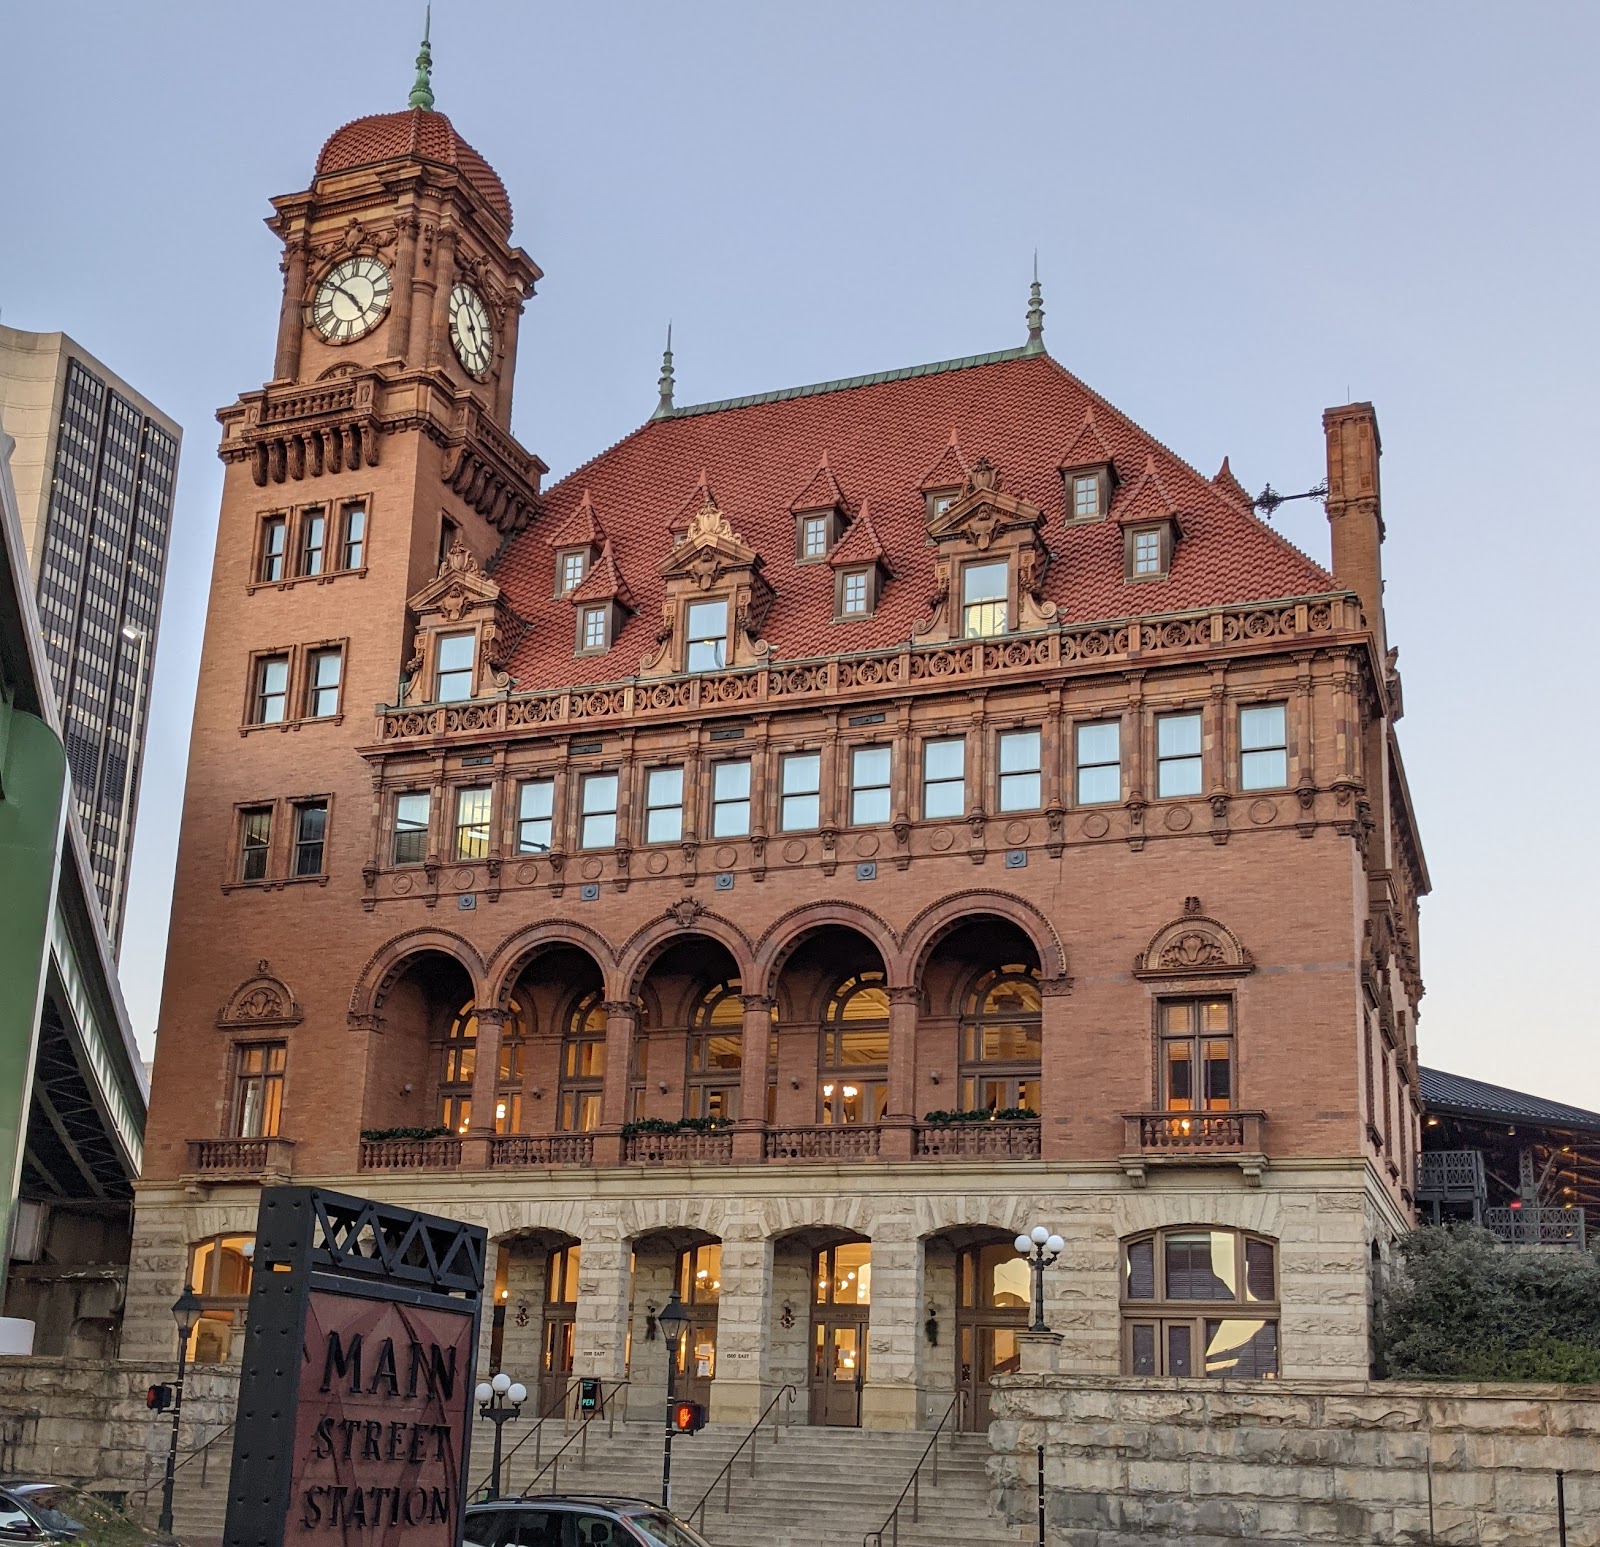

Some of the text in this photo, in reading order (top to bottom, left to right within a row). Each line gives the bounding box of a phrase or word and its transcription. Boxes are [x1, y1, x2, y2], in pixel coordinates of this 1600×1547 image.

[320, 1330, 456, 1400] MAIN
[581, 1398, 595, 1406] PEN
[313, 1416, 451, 1461] STREET
[301, 1484, 450, 1528] STATION
